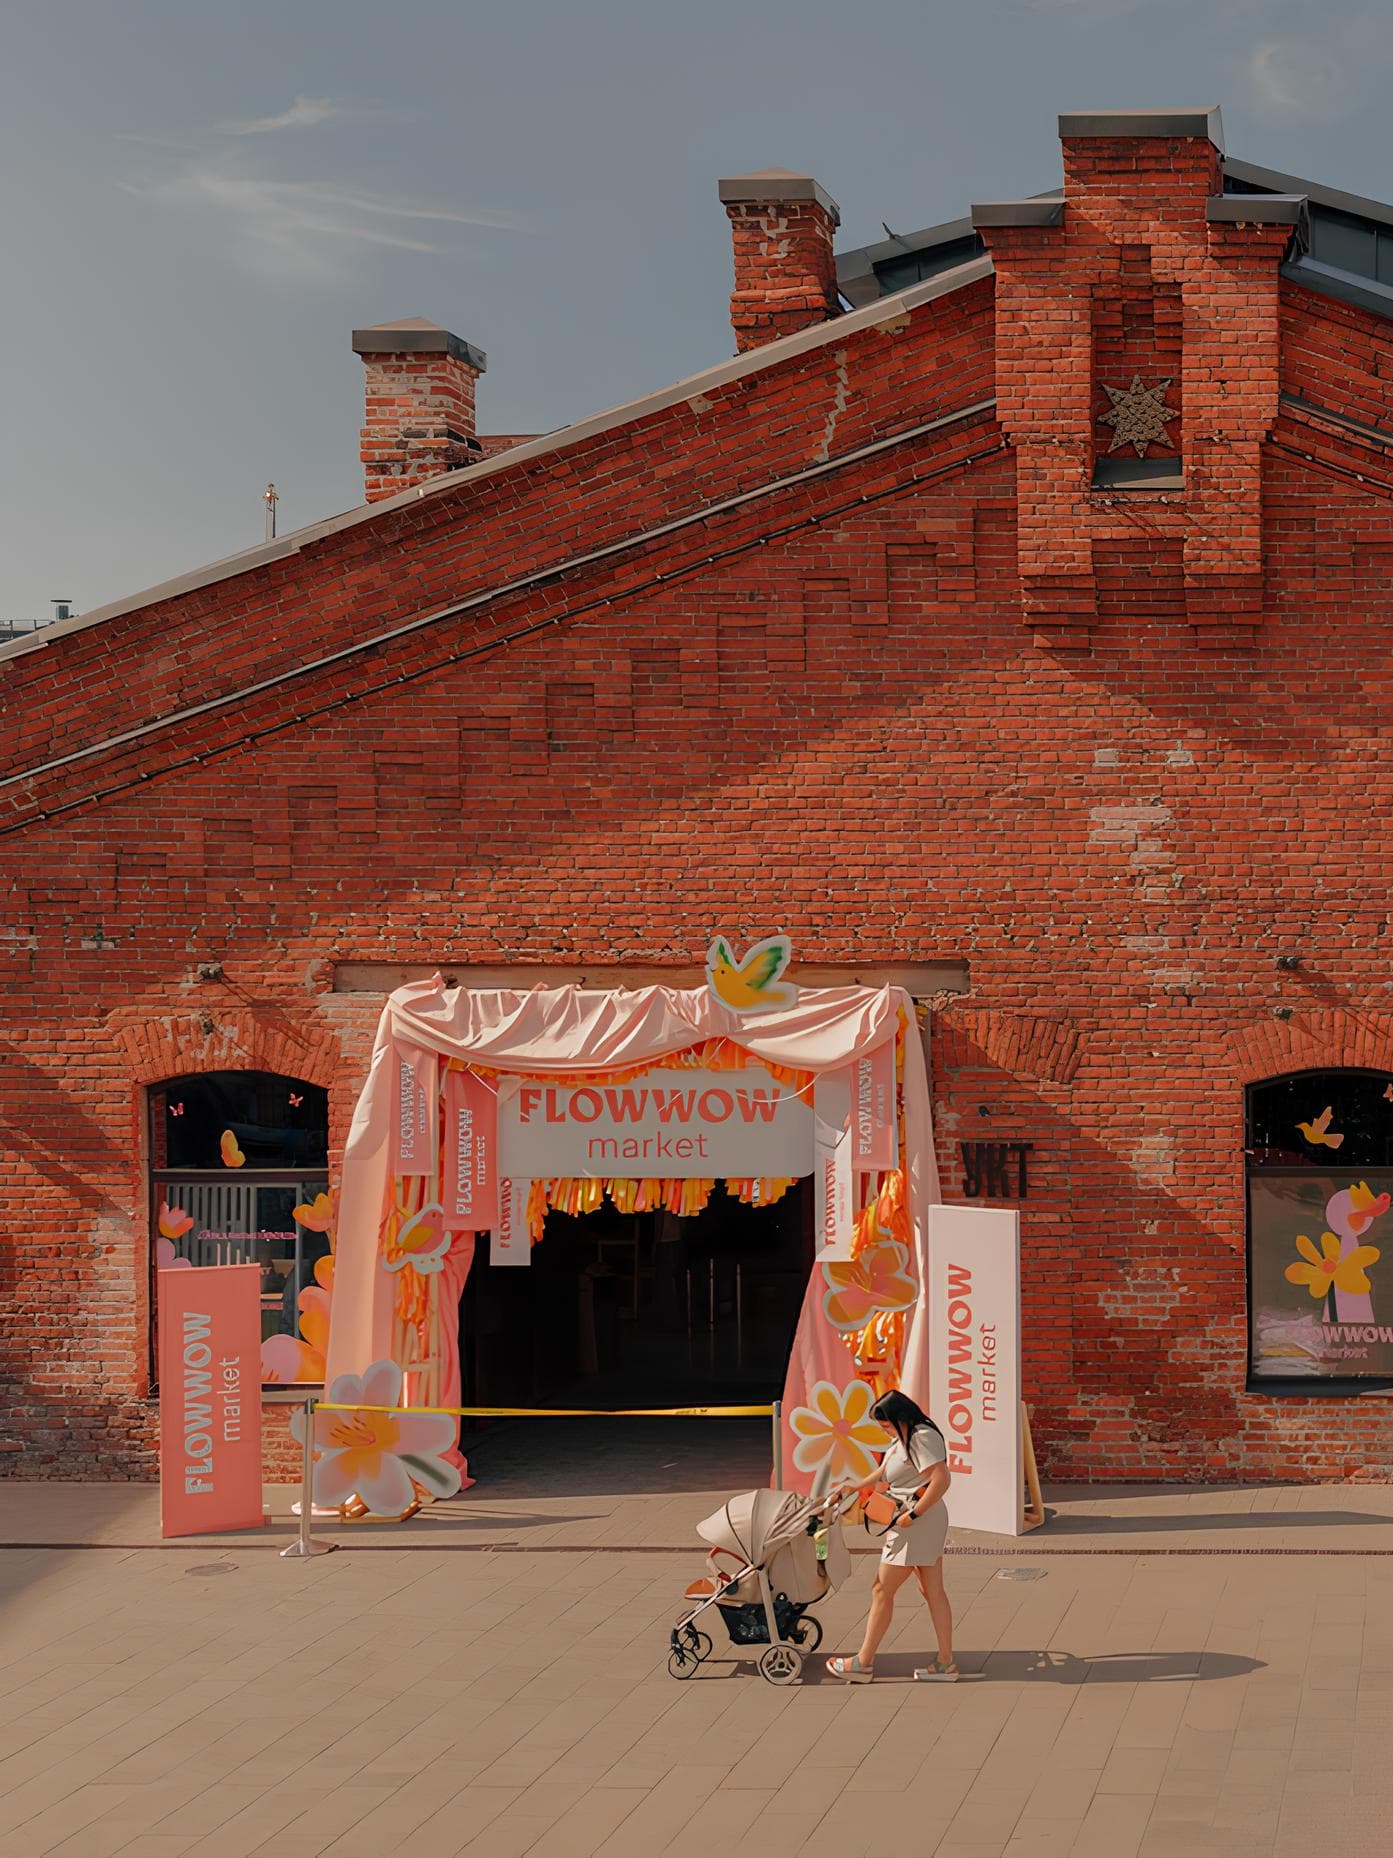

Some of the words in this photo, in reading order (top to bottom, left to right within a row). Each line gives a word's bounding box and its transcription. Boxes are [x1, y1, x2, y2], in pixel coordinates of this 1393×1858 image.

[519, 1087, 781, 1124] FLOWWOW
[587, 1131, 709, 1158] market
[456, 1108, 473, 1215] FLOWWOW
[183, 1312, 214, 1494] FLOWWOW
[217, 1355, 241, 1442] market
[948, 1263, 973, 1475] FLOWWOW
[977, 1323, 997, 1422] market
